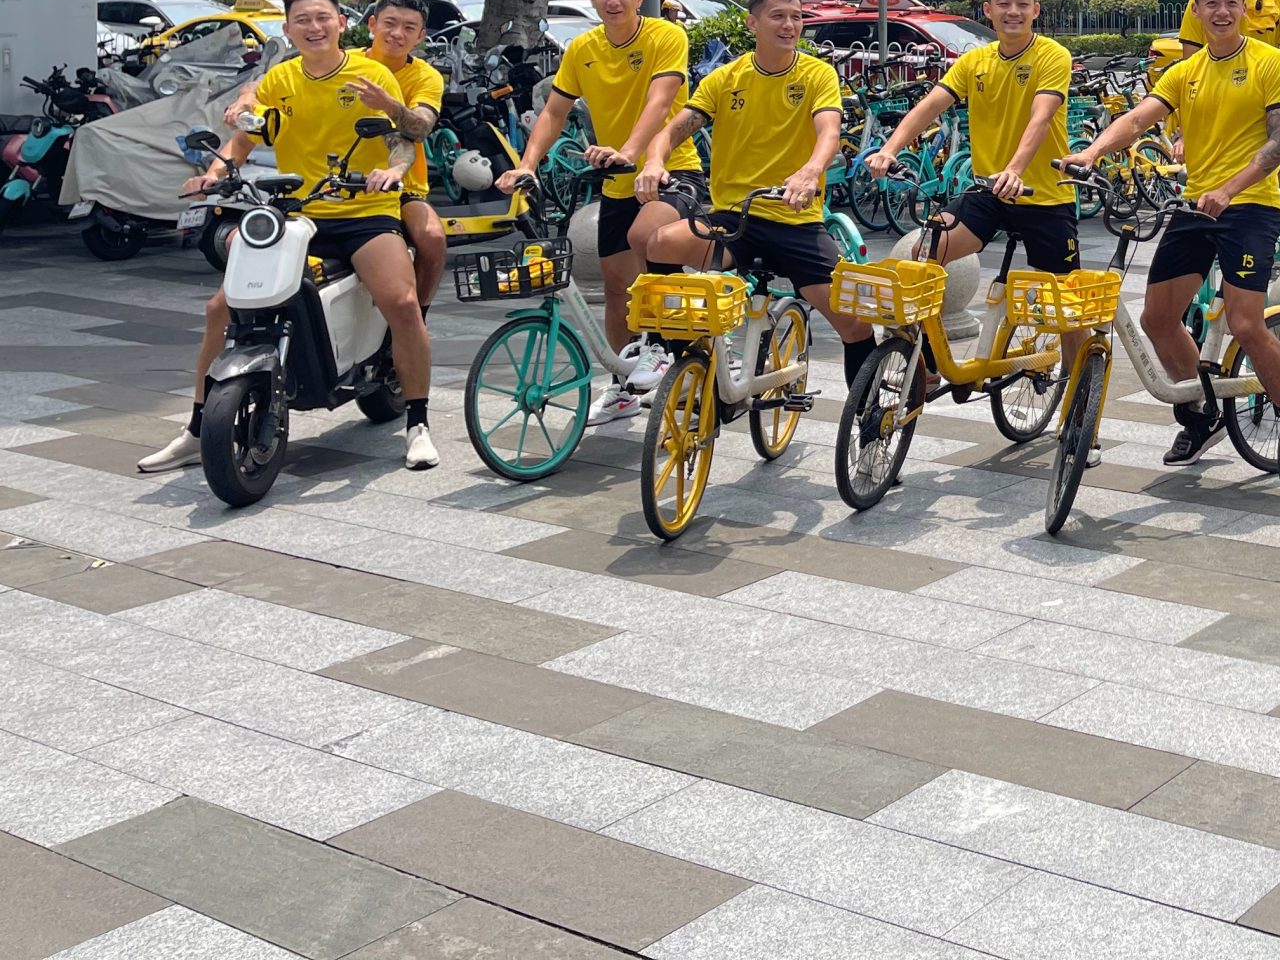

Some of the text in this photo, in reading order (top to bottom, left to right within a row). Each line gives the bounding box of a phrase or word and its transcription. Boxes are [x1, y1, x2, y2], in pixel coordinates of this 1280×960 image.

[281, 104, 293, 117] 38
[730, 98, 745, 110] 29
[1067, 238, 1075, 251] 10
[1242, 254, 1254, 268] 15
